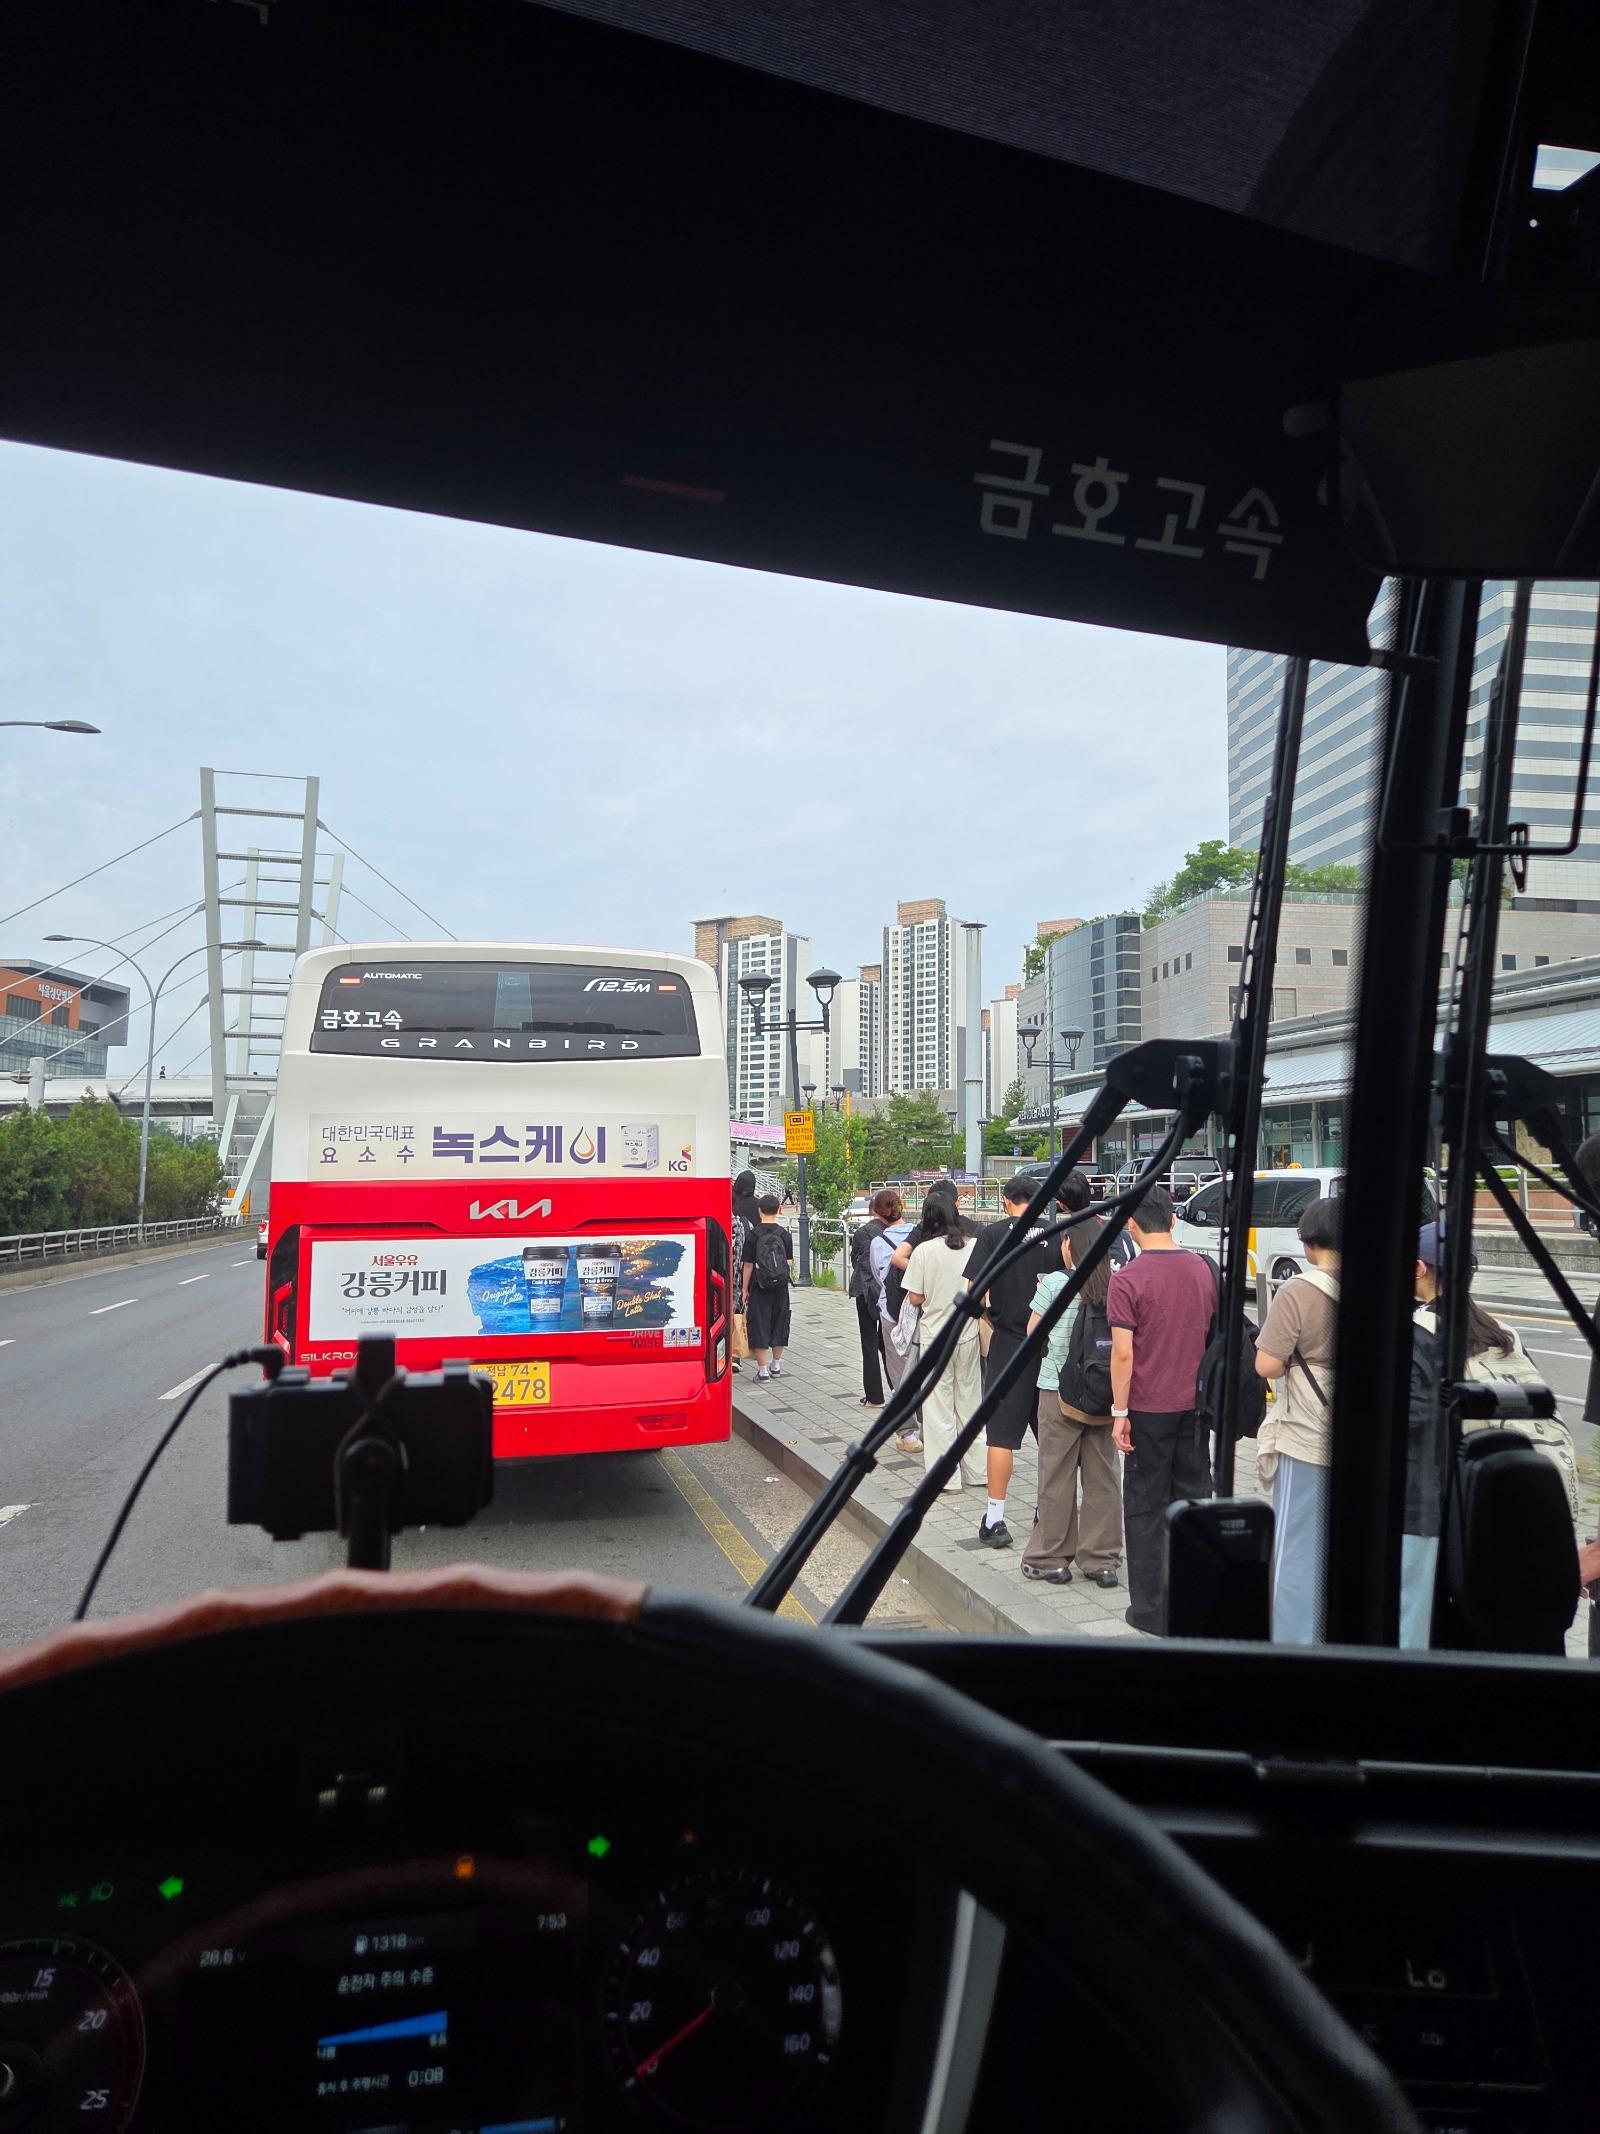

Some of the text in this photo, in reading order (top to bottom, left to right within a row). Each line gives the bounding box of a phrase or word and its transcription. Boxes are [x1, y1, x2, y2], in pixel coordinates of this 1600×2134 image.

[972, 438, 1284, 581] 금호고속
[363, 972, 423, 980] AUTOMATIC
[597, 981, 651, 993] 12.5M
[320, 1009, 403, 1030] 금호고속
[380, 1037, 640, 1051] GRANBIRD
[322, 1125, 415, 1141] 대한민국대표
[668, 1160, 688, 1171] KG
[469, 1198, 552, 1219] KIA
[372, 1254, 418, 1267] 서울우유
[529, 1268, 563, 1277] 강릉커피
[582, 1266, 615, 1276] 강릉커피
[340, 1268, 447, 1298] 강릉커피
[481, 1285, 517, 1303] Original
[503, 1294, 524, 1307] Latte
[616, 1295, 644, 1311] Double
[624, 1306, 643, 1318] Latte
[486, 1364, 530, 1376] 전남 74
[636, 1947, 661, 1967] 40
[33, 1968, 58, 1988] 15
[338, 1966, 434, 1995] 운전자 주의 수준
[78, 2009, 108, 2031] 20
[629, 2001, 652, 2022] 20
[407, 2066, 445, 2088] 0:08
[80, 2089, 110, 2111] 25
